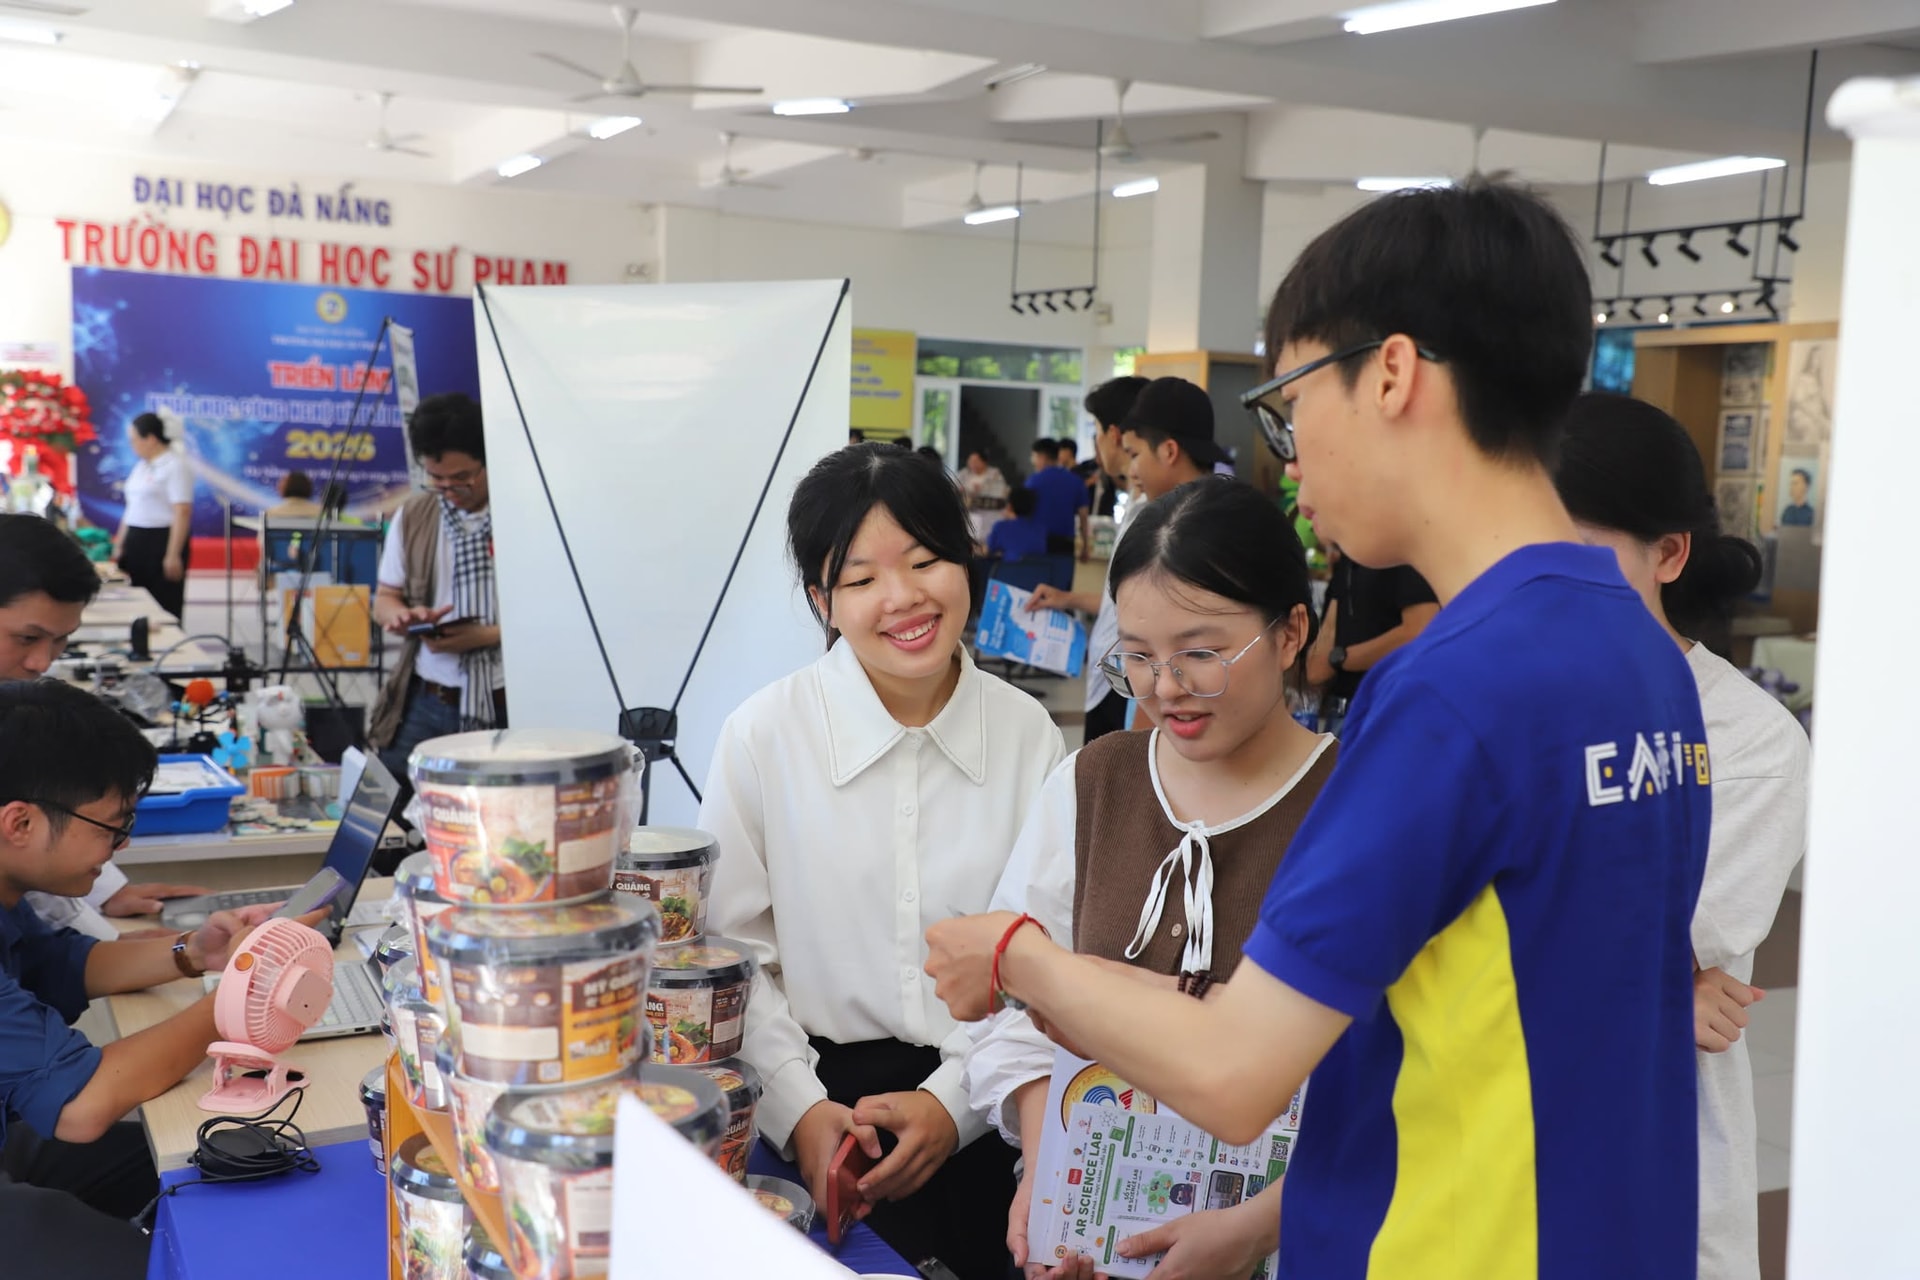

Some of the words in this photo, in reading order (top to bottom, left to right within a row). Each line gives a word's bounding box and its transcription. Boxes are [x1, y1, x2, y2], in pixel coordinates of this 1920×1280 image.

[196, 183, 254, 220] HỌC
[267, 183, 304, 218] ĐÀ
[55, 212, 217, 274] TRƯỜNG
[1089, 1132, 1103, 1156] LAB
[1079, 1160, 1098, 1215] SCIENCE
[1075, 1219, 1087, 1237] AR
